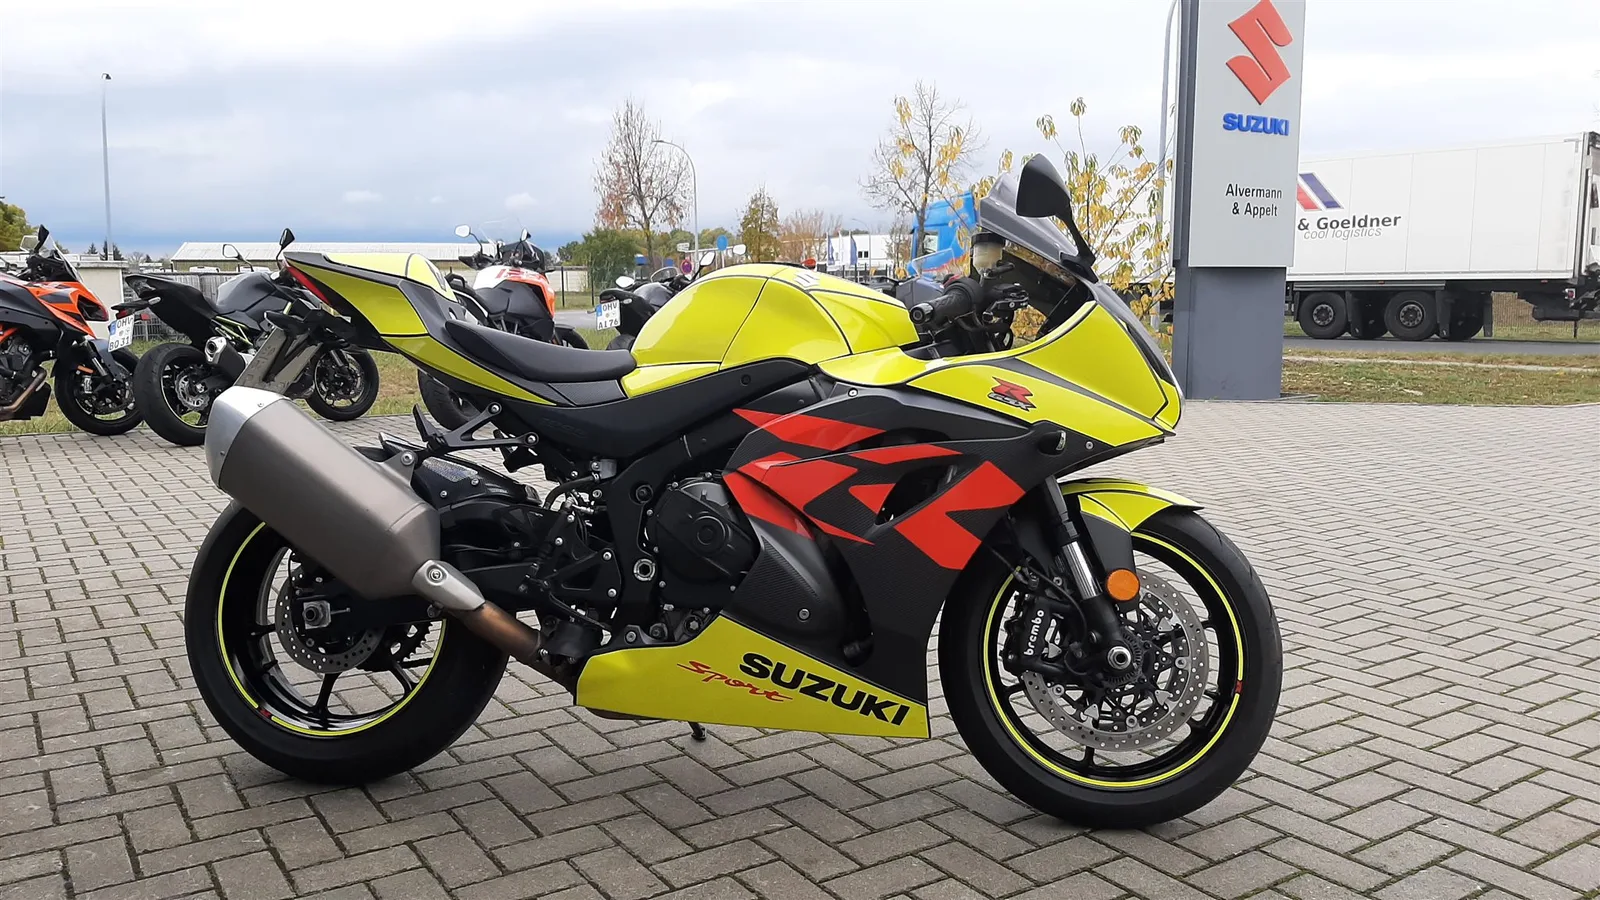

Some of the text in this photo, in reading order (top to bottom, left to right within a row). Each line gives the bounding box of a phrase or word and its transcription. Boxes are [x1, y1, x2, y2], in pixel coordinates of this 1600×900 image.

[1222, 112, 1290, 136] SUZUKI
[1225, 183, 1282, 199] Alvermann
[1232, 201, 1278, 219] & Appelt
[1297, 214, 1402, 231] & Goeldner
[1303, 227, 1382, 241] cool logistics
[1023, 609, 1045, 656] brembo
[677, 660, 794, 702] Sport
[738, 652, 911, 726] SUZUKI
